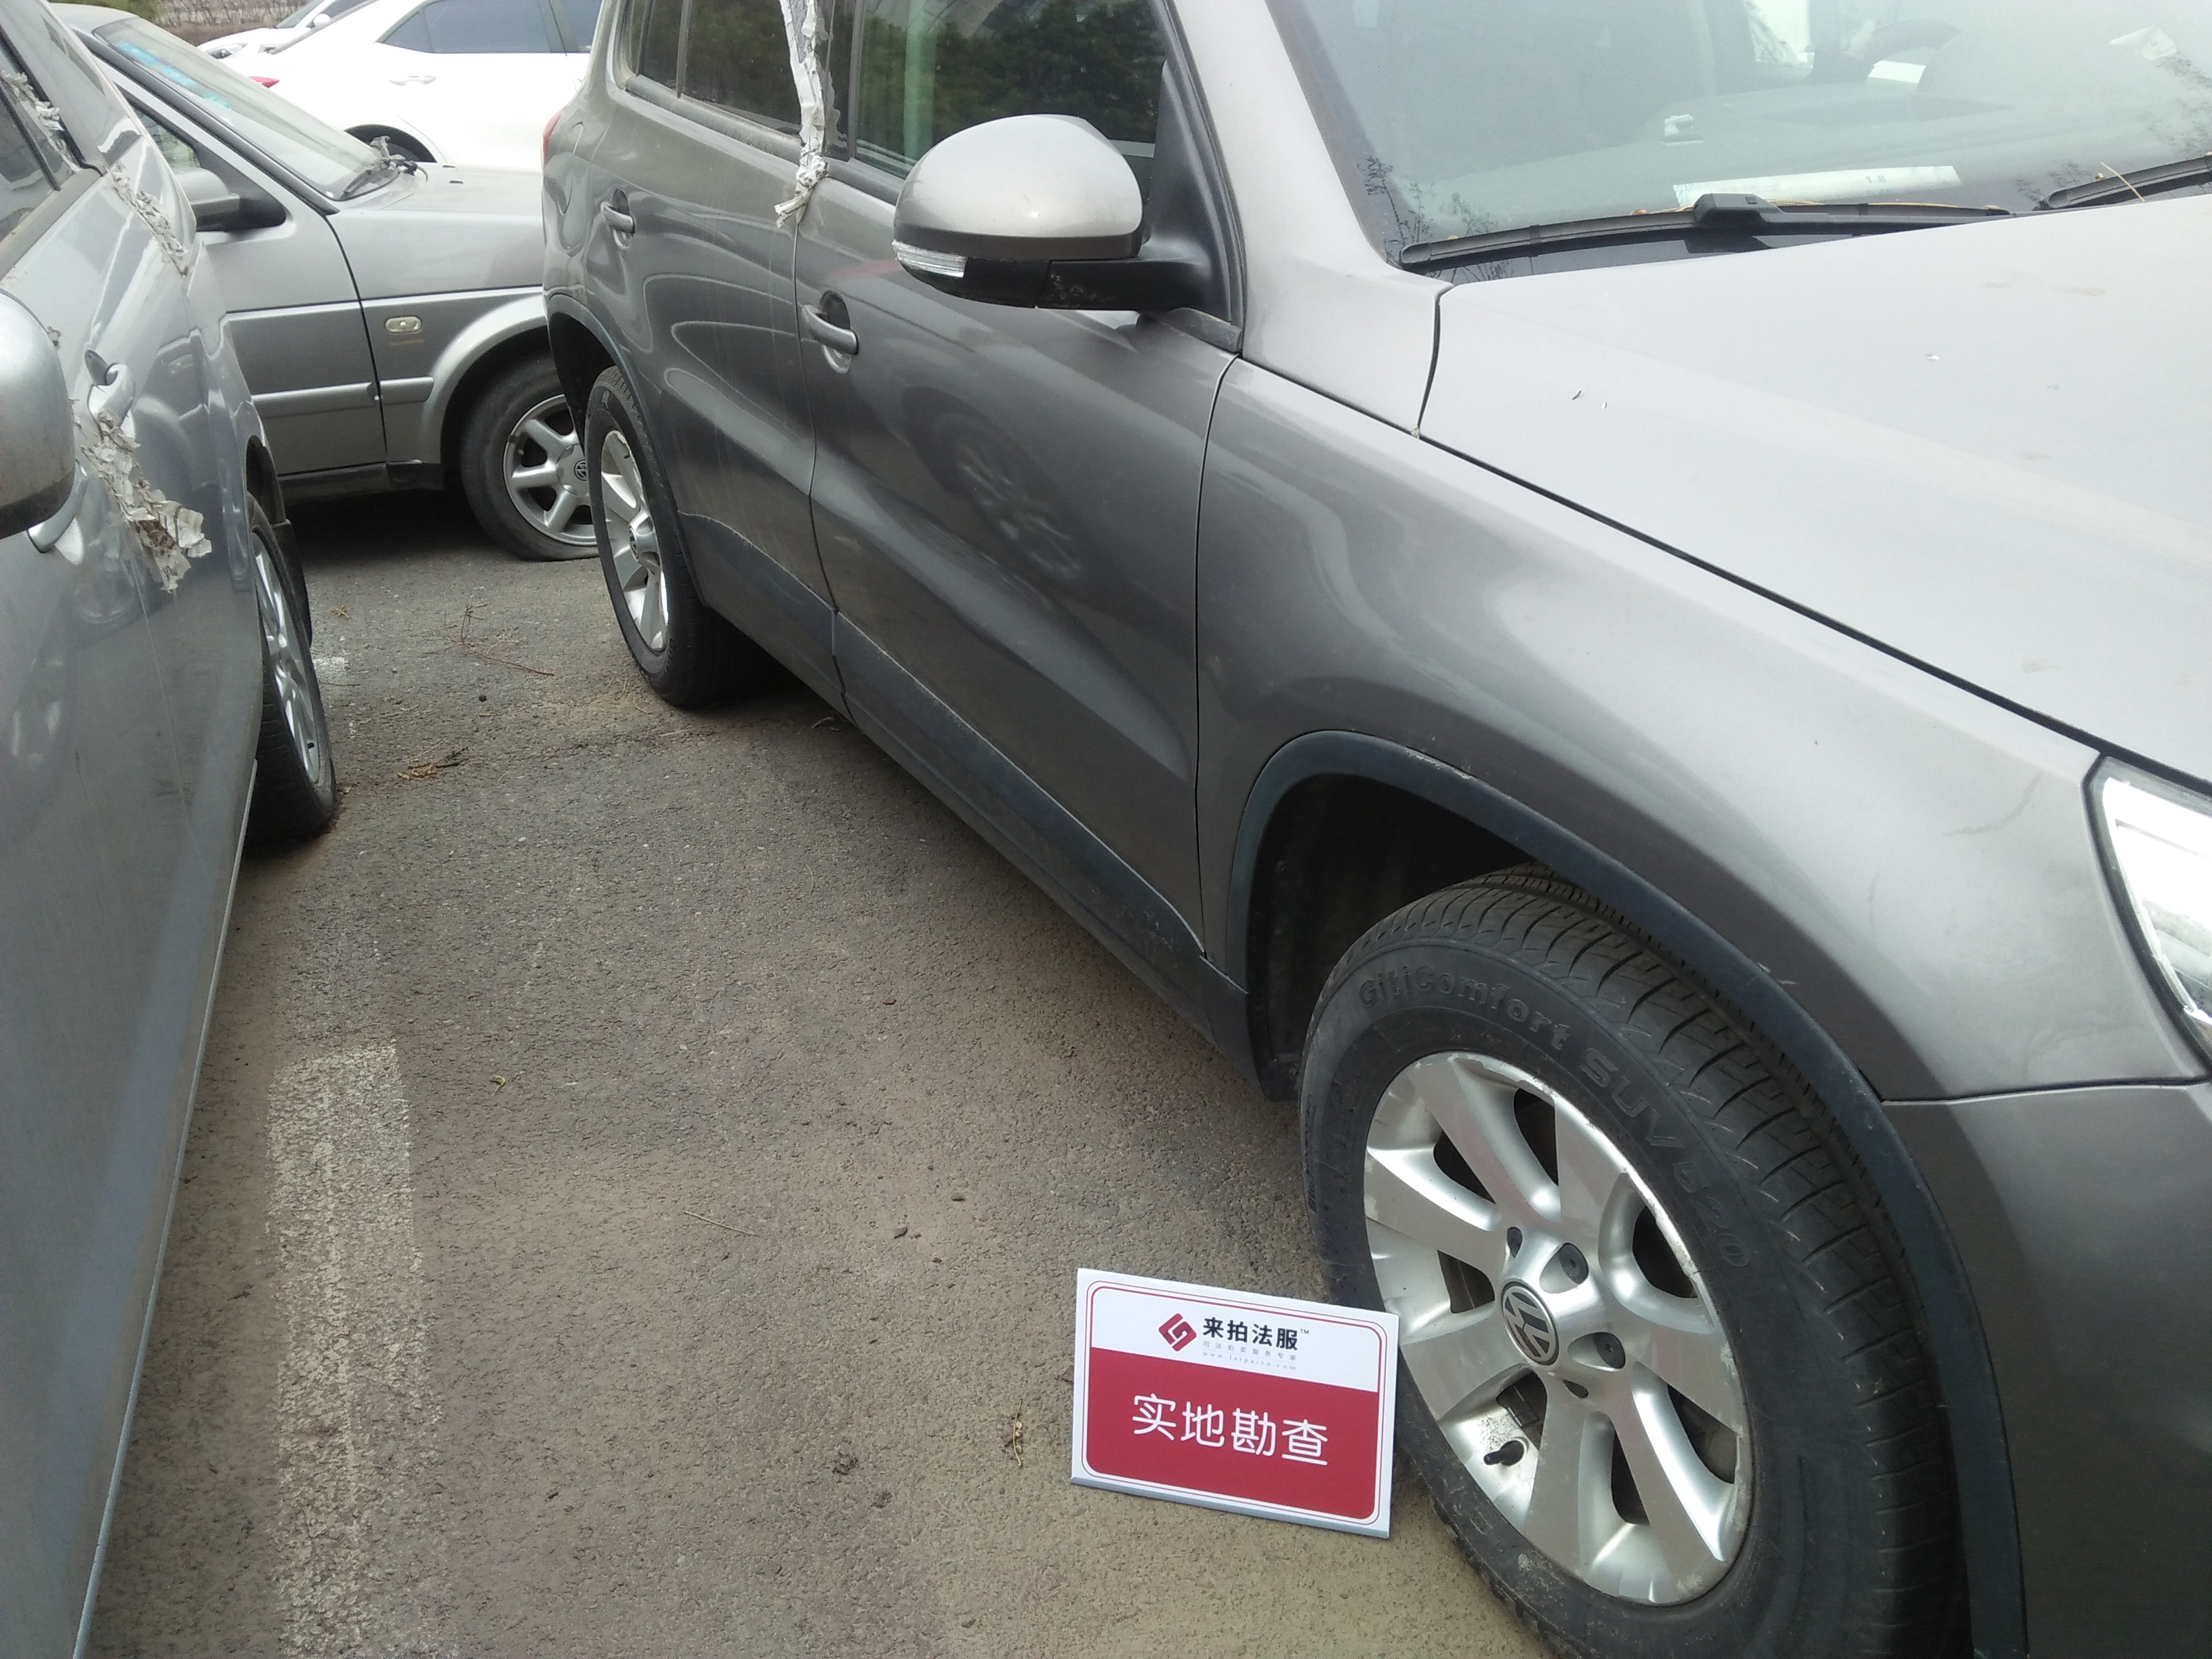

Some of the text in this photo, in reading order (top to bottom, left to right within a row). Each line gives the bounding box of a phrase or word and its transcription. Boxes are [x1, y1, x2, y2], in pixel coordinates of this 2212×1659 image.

[1580, 1048, 1683, 1147] SUV
[1203, 1317, 1298, 1351] 来拍法服
[1132, 1393, 1328, 1466] 实地勘查
